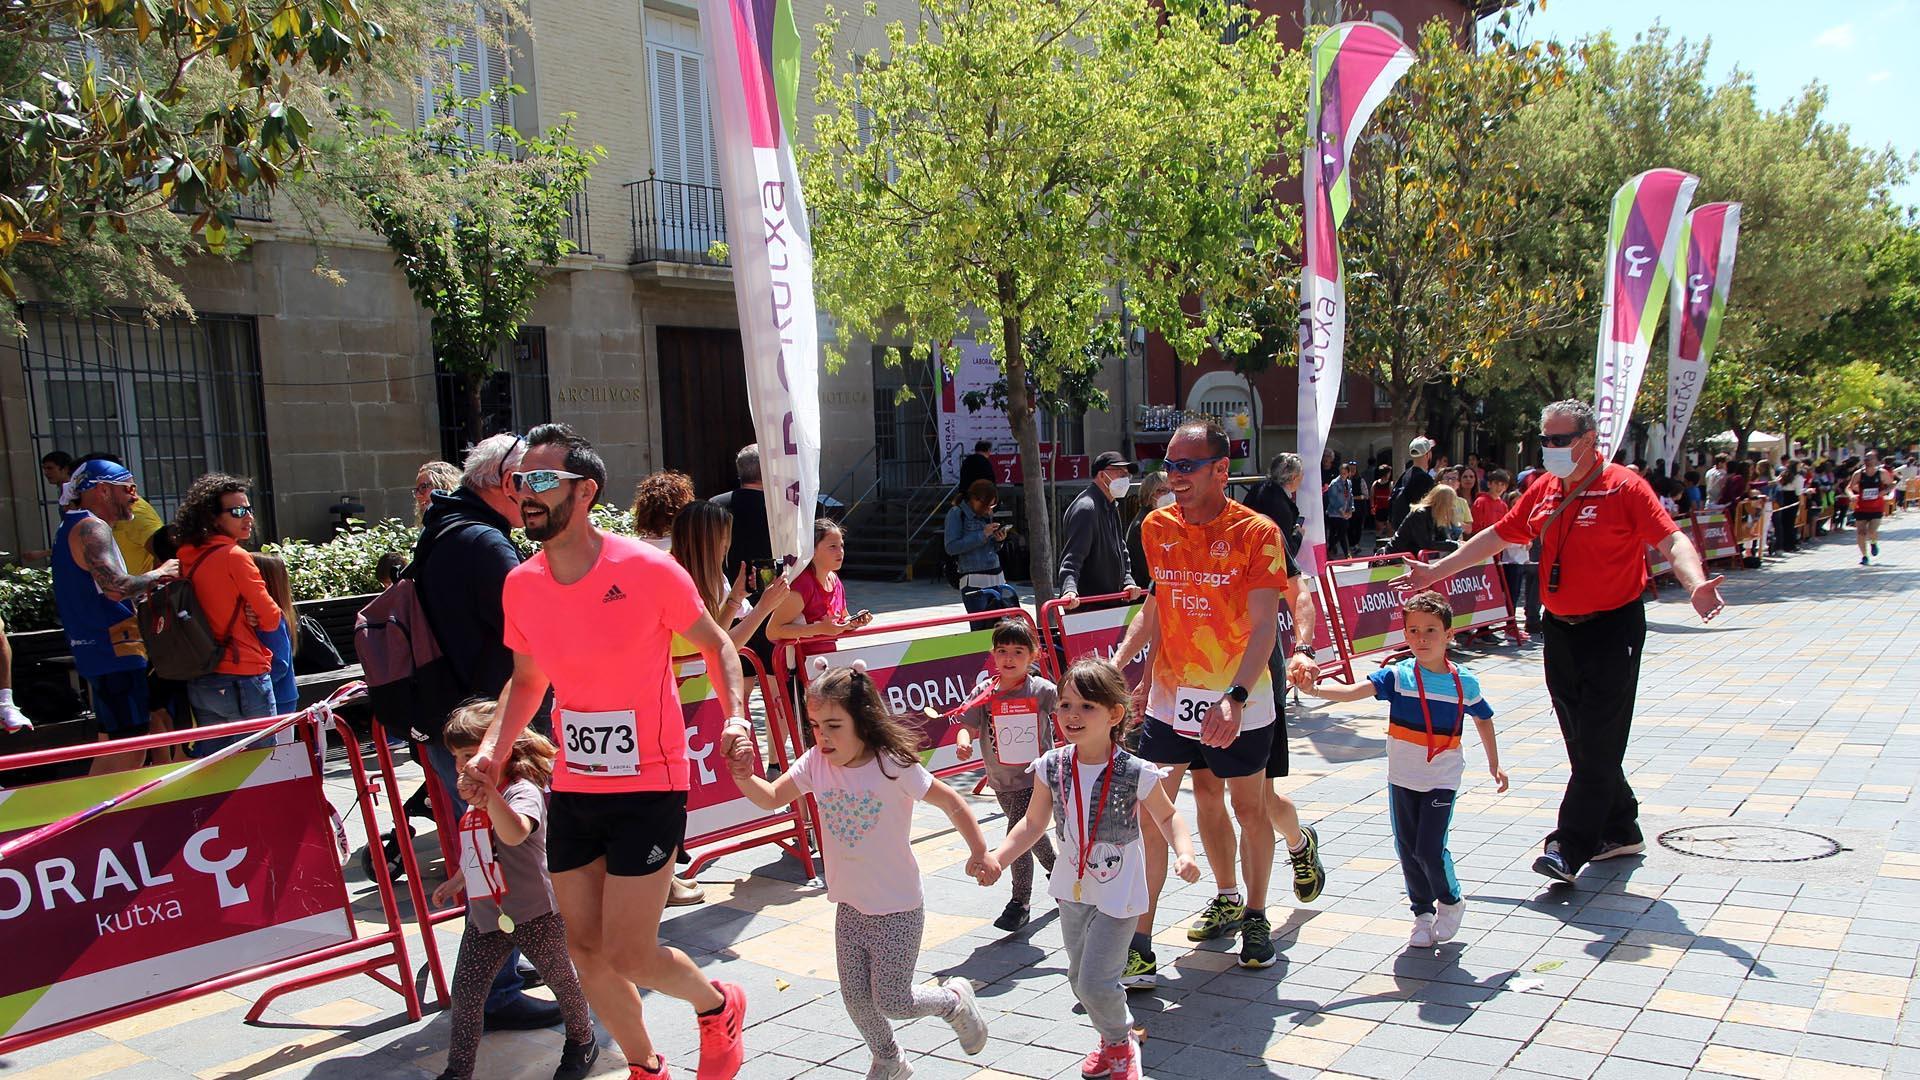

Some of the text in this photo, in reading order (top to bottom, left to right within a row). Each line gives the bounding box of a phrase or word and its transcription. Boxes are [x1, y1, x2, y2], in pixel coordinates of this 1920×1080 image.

[558, 386, 640, 401] ARCHIVOS
[1004, 468, 1011, 483] 2
[1072, 465, 1079, 478] 3
[1445, 575, 1483, 596] LABORAL
[1353, 592, 1398, 614] LABORAL
[1178, 699, 1215, 722] 36
[566, 723, 635, 755] 3673
[96, 899, 183, 936] kutxa
